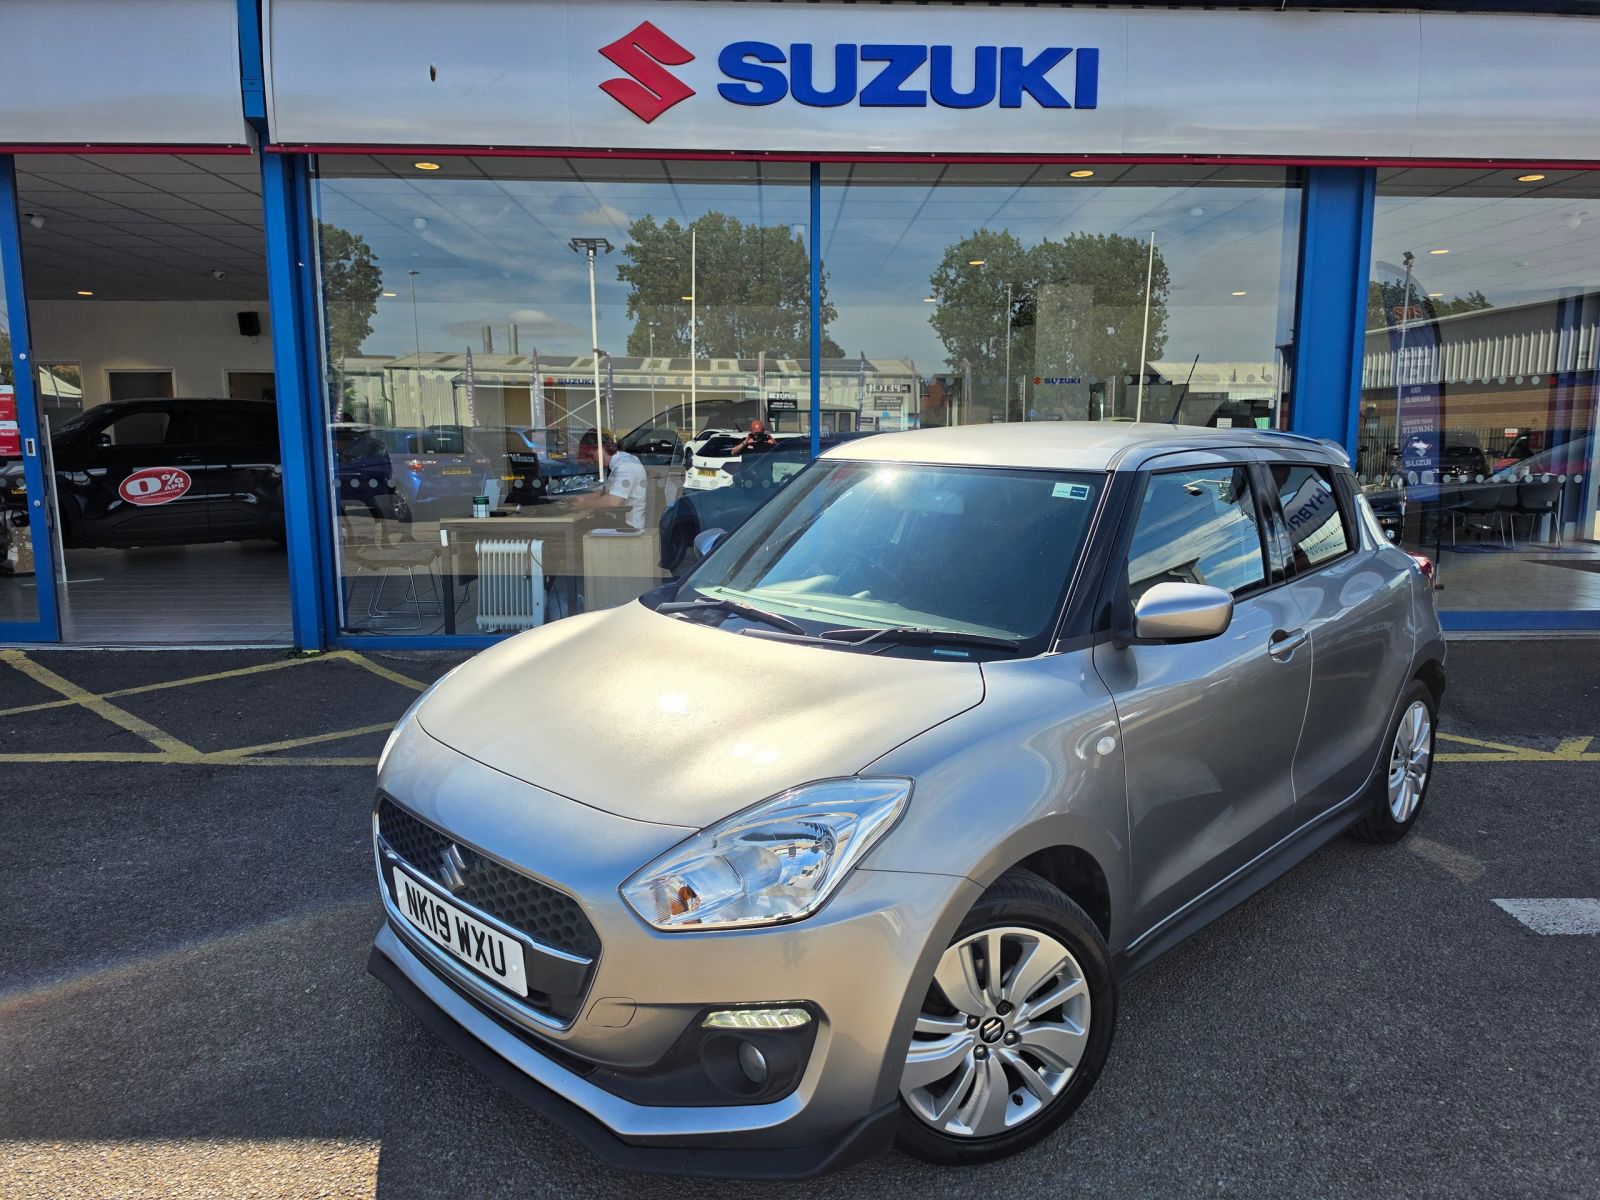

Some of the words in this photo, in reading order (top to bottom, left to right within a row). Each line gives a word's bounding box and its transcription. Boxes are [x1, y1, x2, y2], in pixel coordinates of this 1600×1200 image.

[717, 41, 1099, 109] SUZUKI
[165, 483, 184, 491] APR
[404, 881, 452, 944] NK19
[455, 915, 507, 978] WXU
